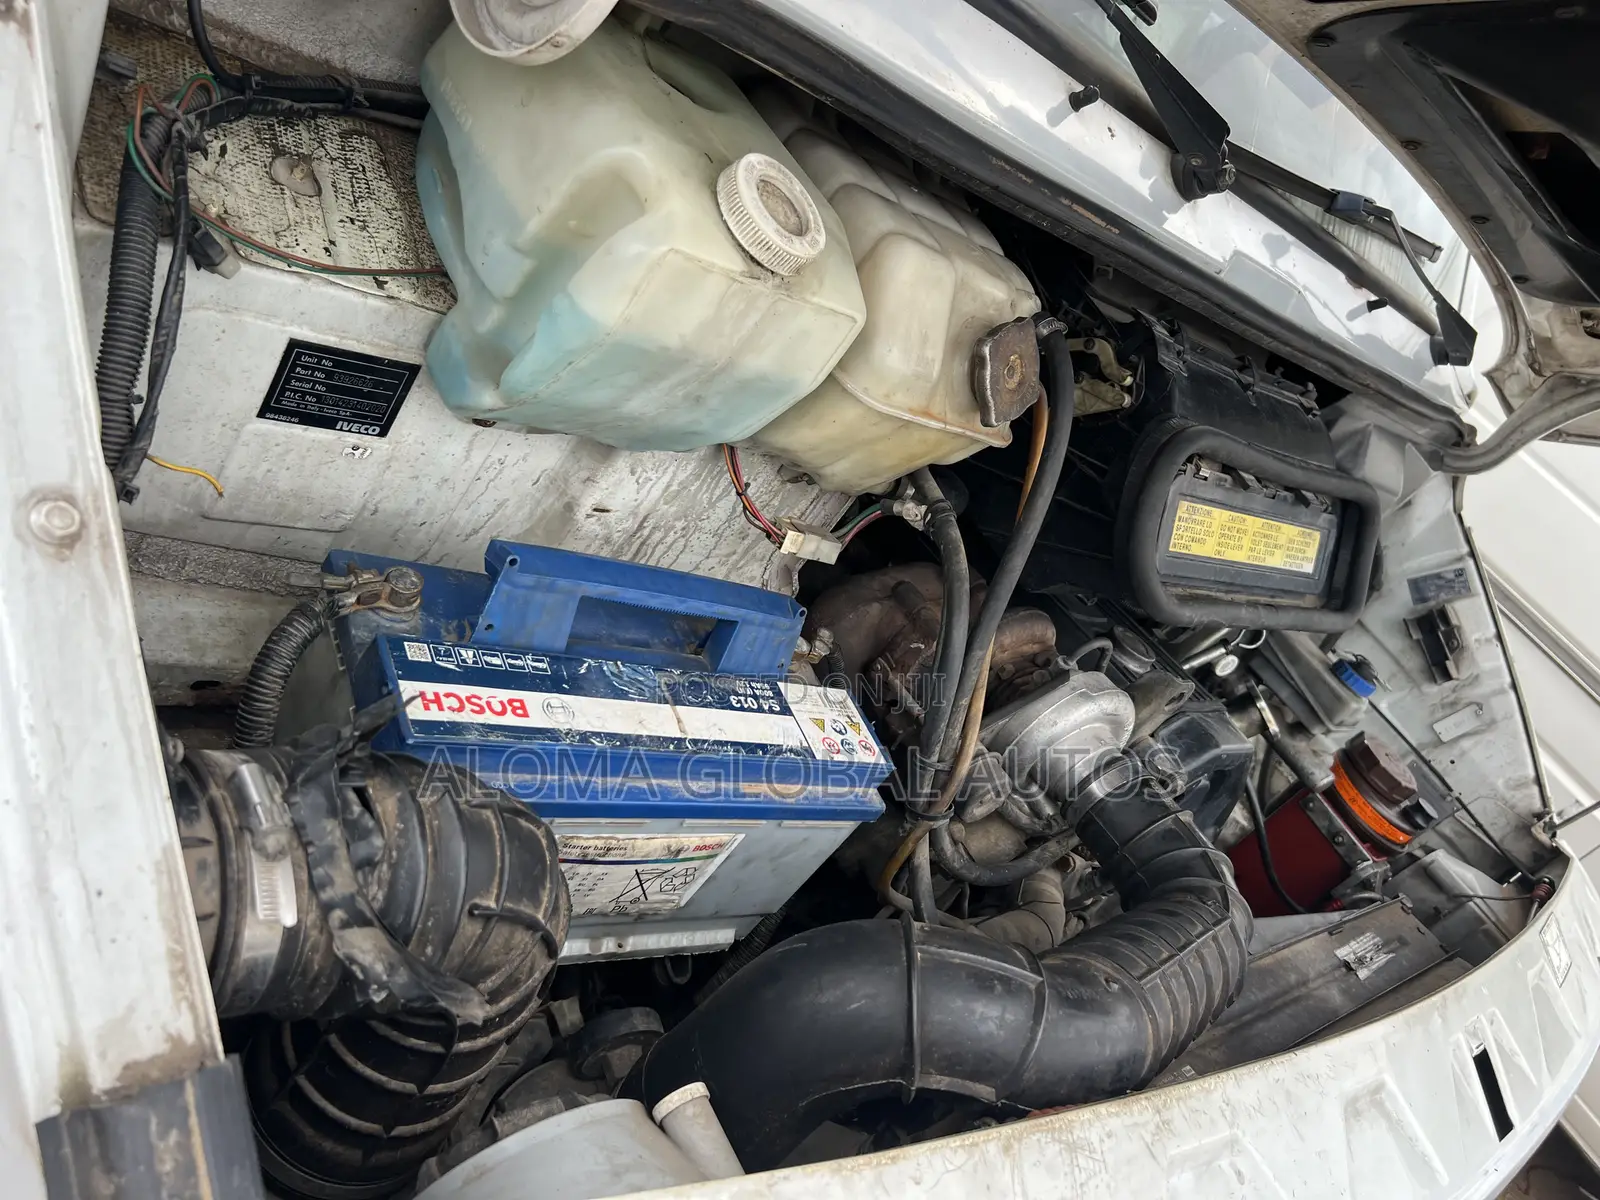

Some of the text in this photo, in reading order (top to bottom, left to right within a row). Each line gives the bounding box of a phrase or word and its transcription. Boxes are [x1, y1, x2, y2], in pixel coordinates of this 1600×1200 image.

[301, 354, 333, 367] Unit No
[296, 367, 312, 376] Part
[314, 370, 326, 379] No
[290, 379, 326, 392] Serial No
[284, 391, 302, 401] P.I.C.
[305, 394, 316, 403] No
[336, 420, 380, 435] IVECO
[1174, 533, 1184, 541] CON
[1203, 530, 1214, 538] SOLO
[422, 690, 530, 718] BOSCH
[730, 695, 780, 712] S4 013
[562, 843, 592, 851] Starter
[692, 842, 724, 852] BOSCH
[610, 905, 628, 914] Pb
